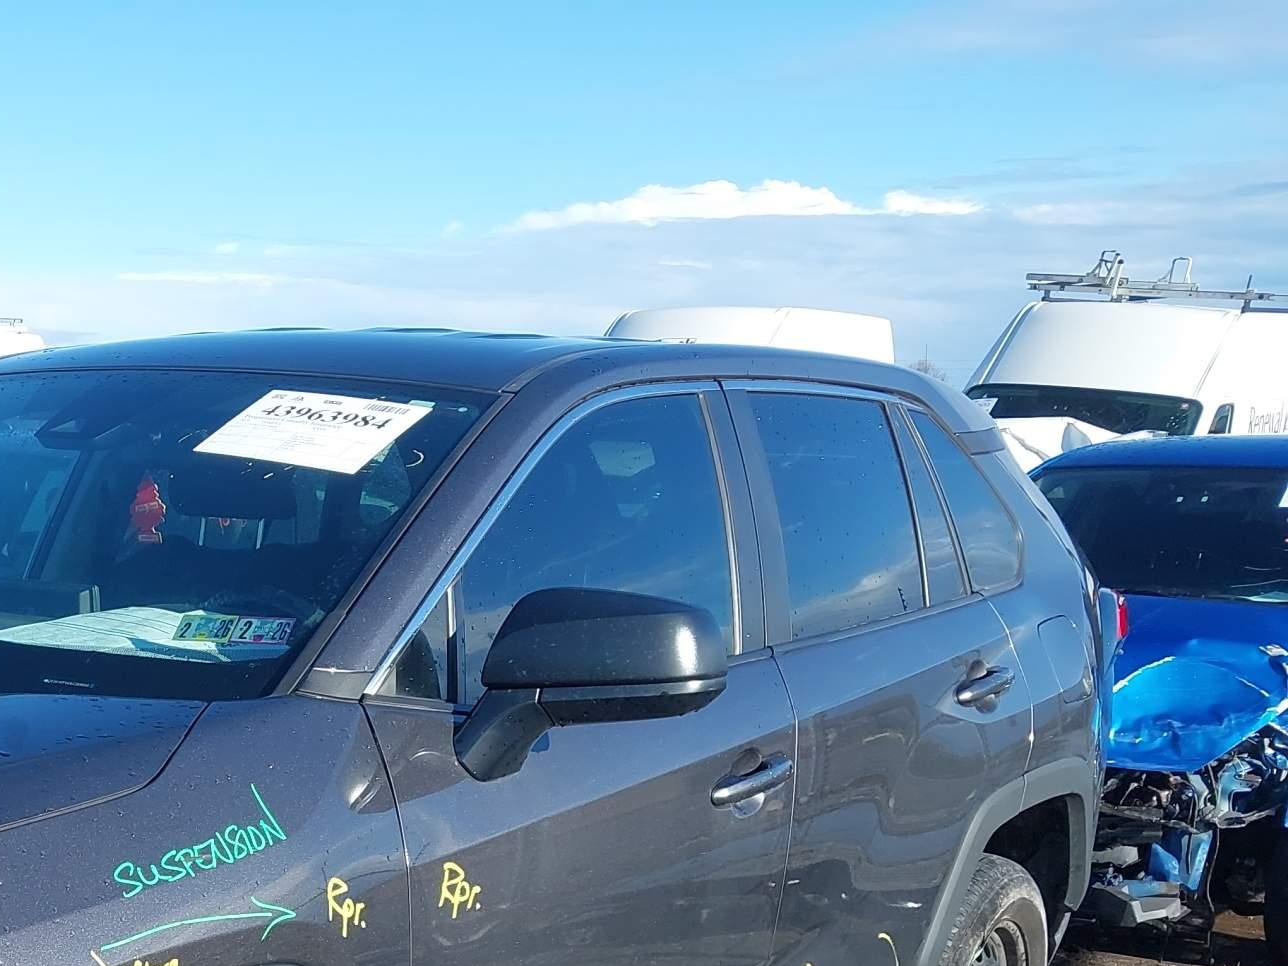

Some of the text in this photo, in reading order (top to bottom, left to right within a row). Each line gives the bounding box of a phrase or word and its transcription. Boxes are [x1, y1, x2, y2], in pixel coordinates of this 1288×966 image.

[262, 404, 393, 430] 43963984
[178, 619, 234, 639] 2 26
[238, 620, 291, 640] 2 26
[113, 784, 287, 898] SUSPENSION
